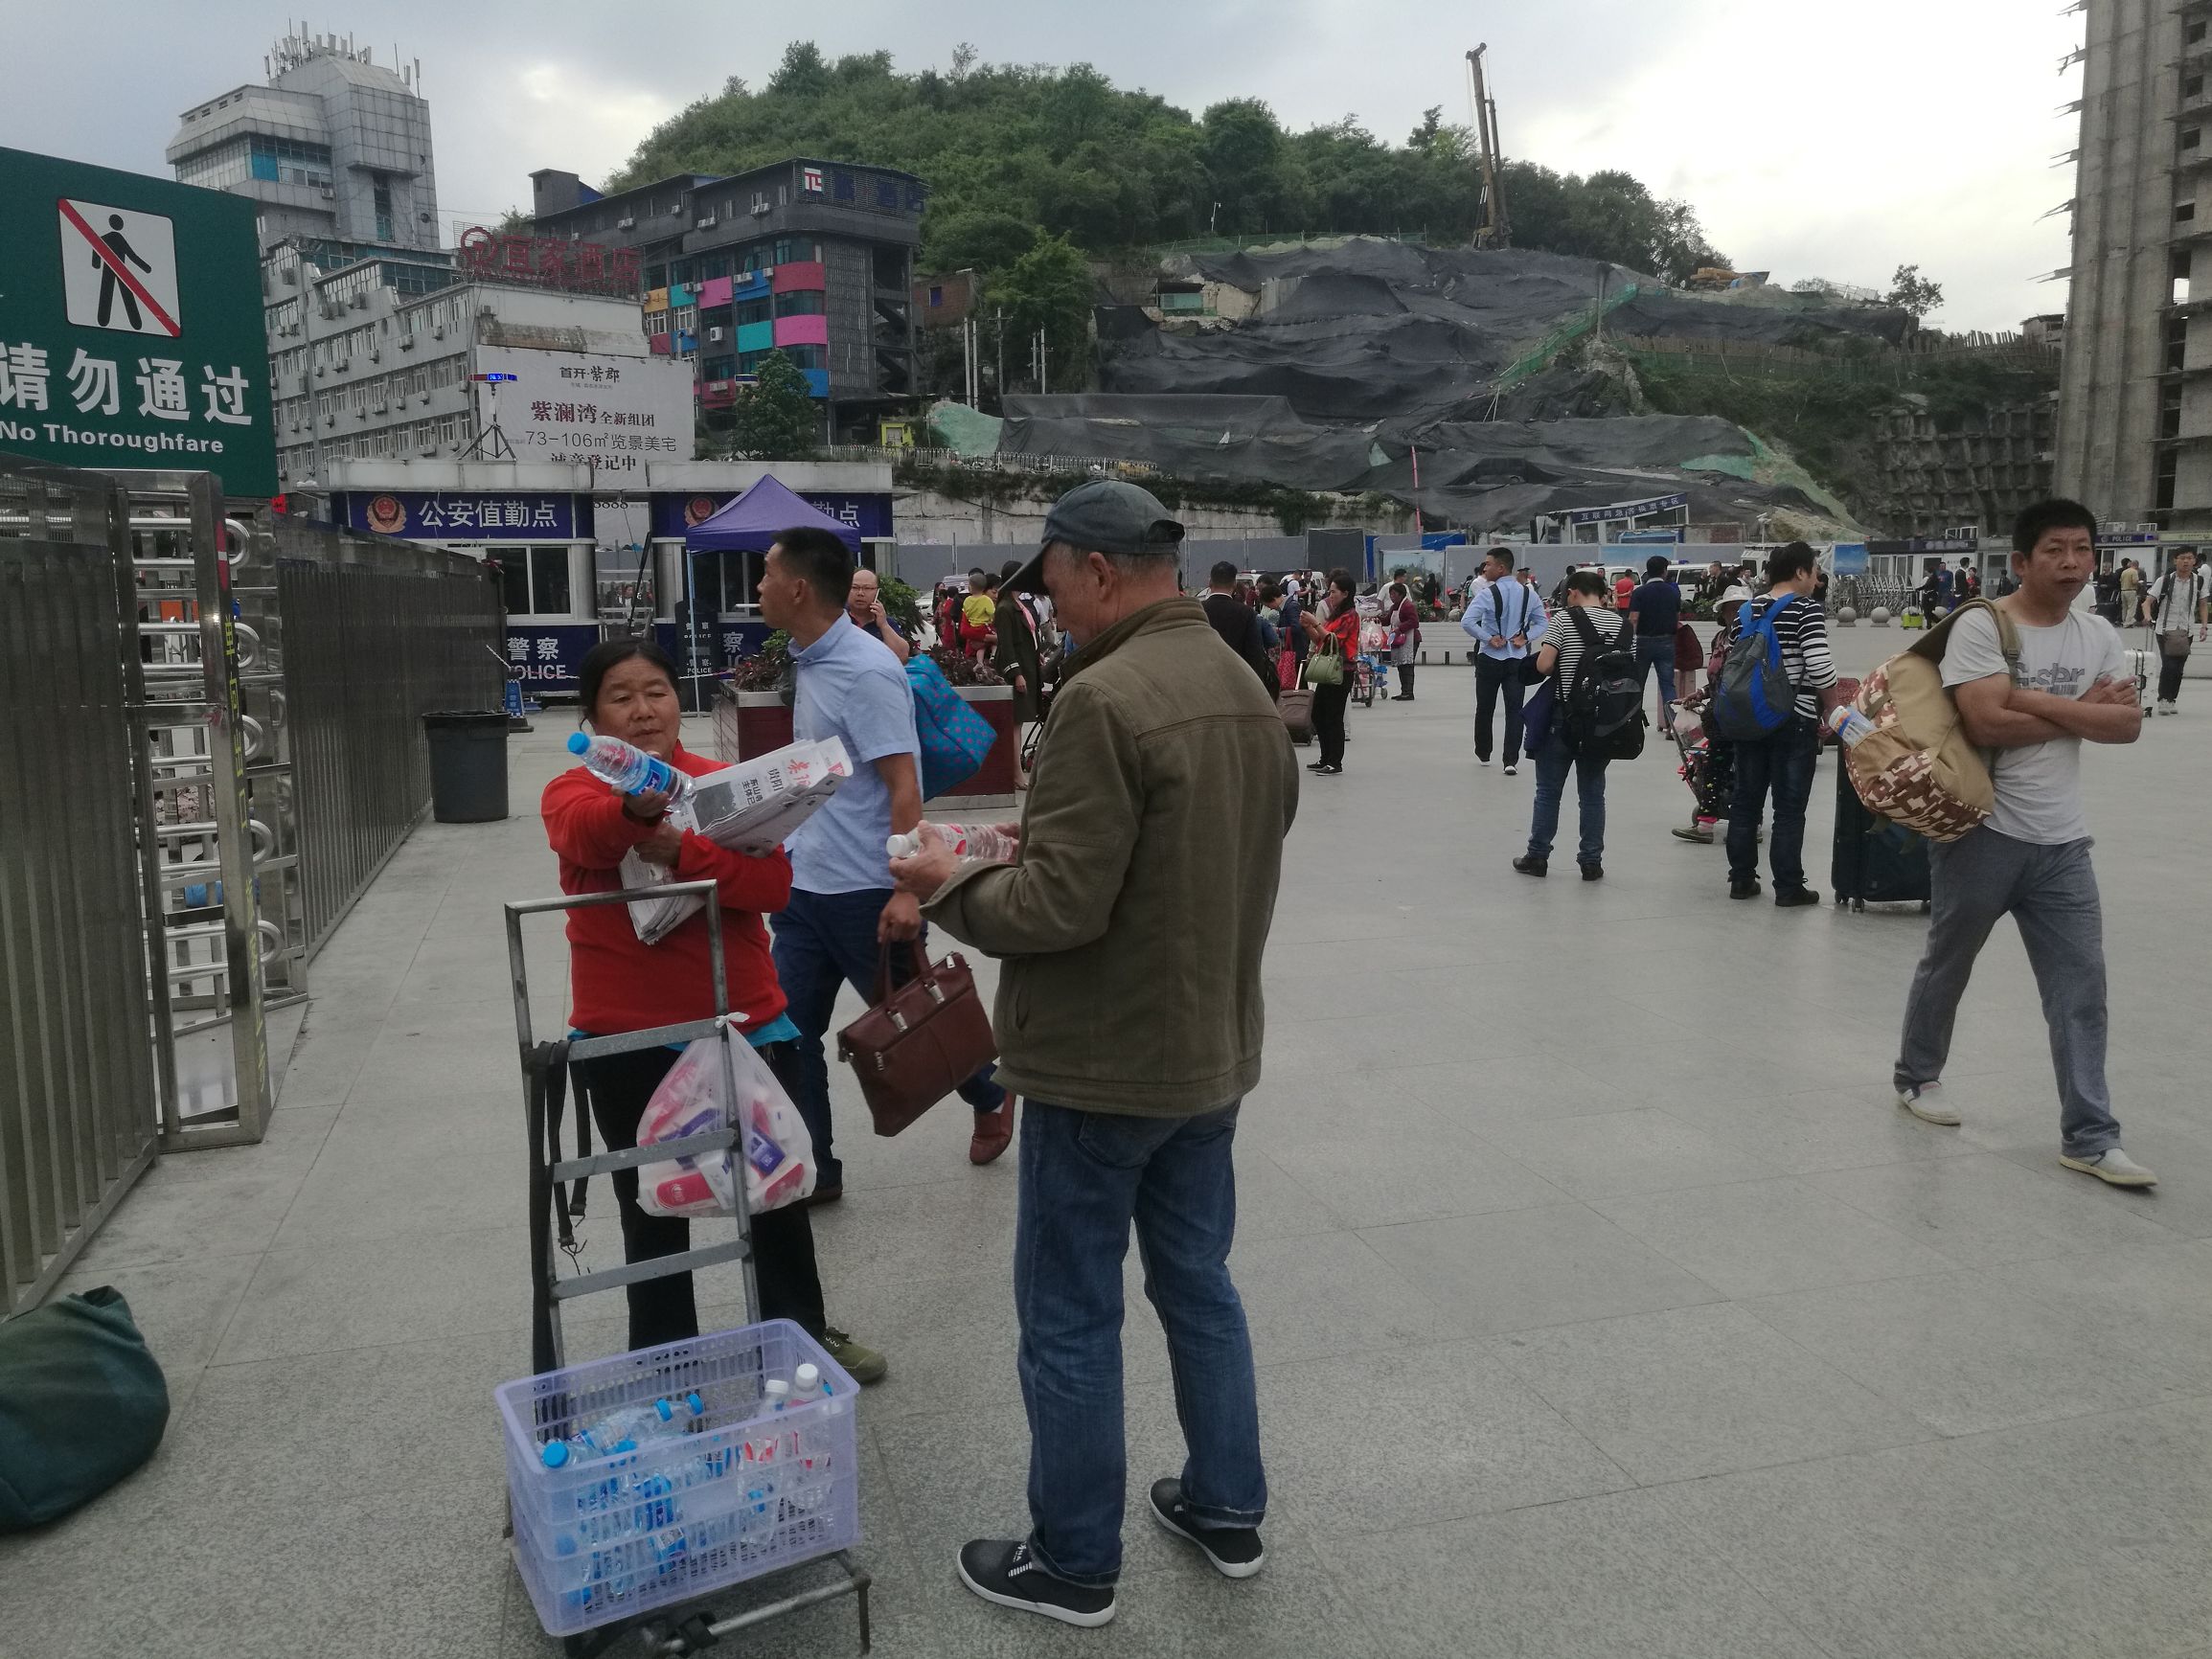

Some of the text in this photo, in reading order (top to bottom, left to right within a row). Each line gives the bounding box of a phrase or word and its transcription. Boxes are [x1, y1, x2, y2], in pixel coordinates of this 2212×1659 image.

[0, 341, 253, 426] 请勿通过
[531, 400, 655, 427] 紫澜湾 全新组团
[0, 421, 224, 454] No Thoroughfare
[419, 499, 559, 528] 公安值勤点
[507, 636, 559, 661] 警察
